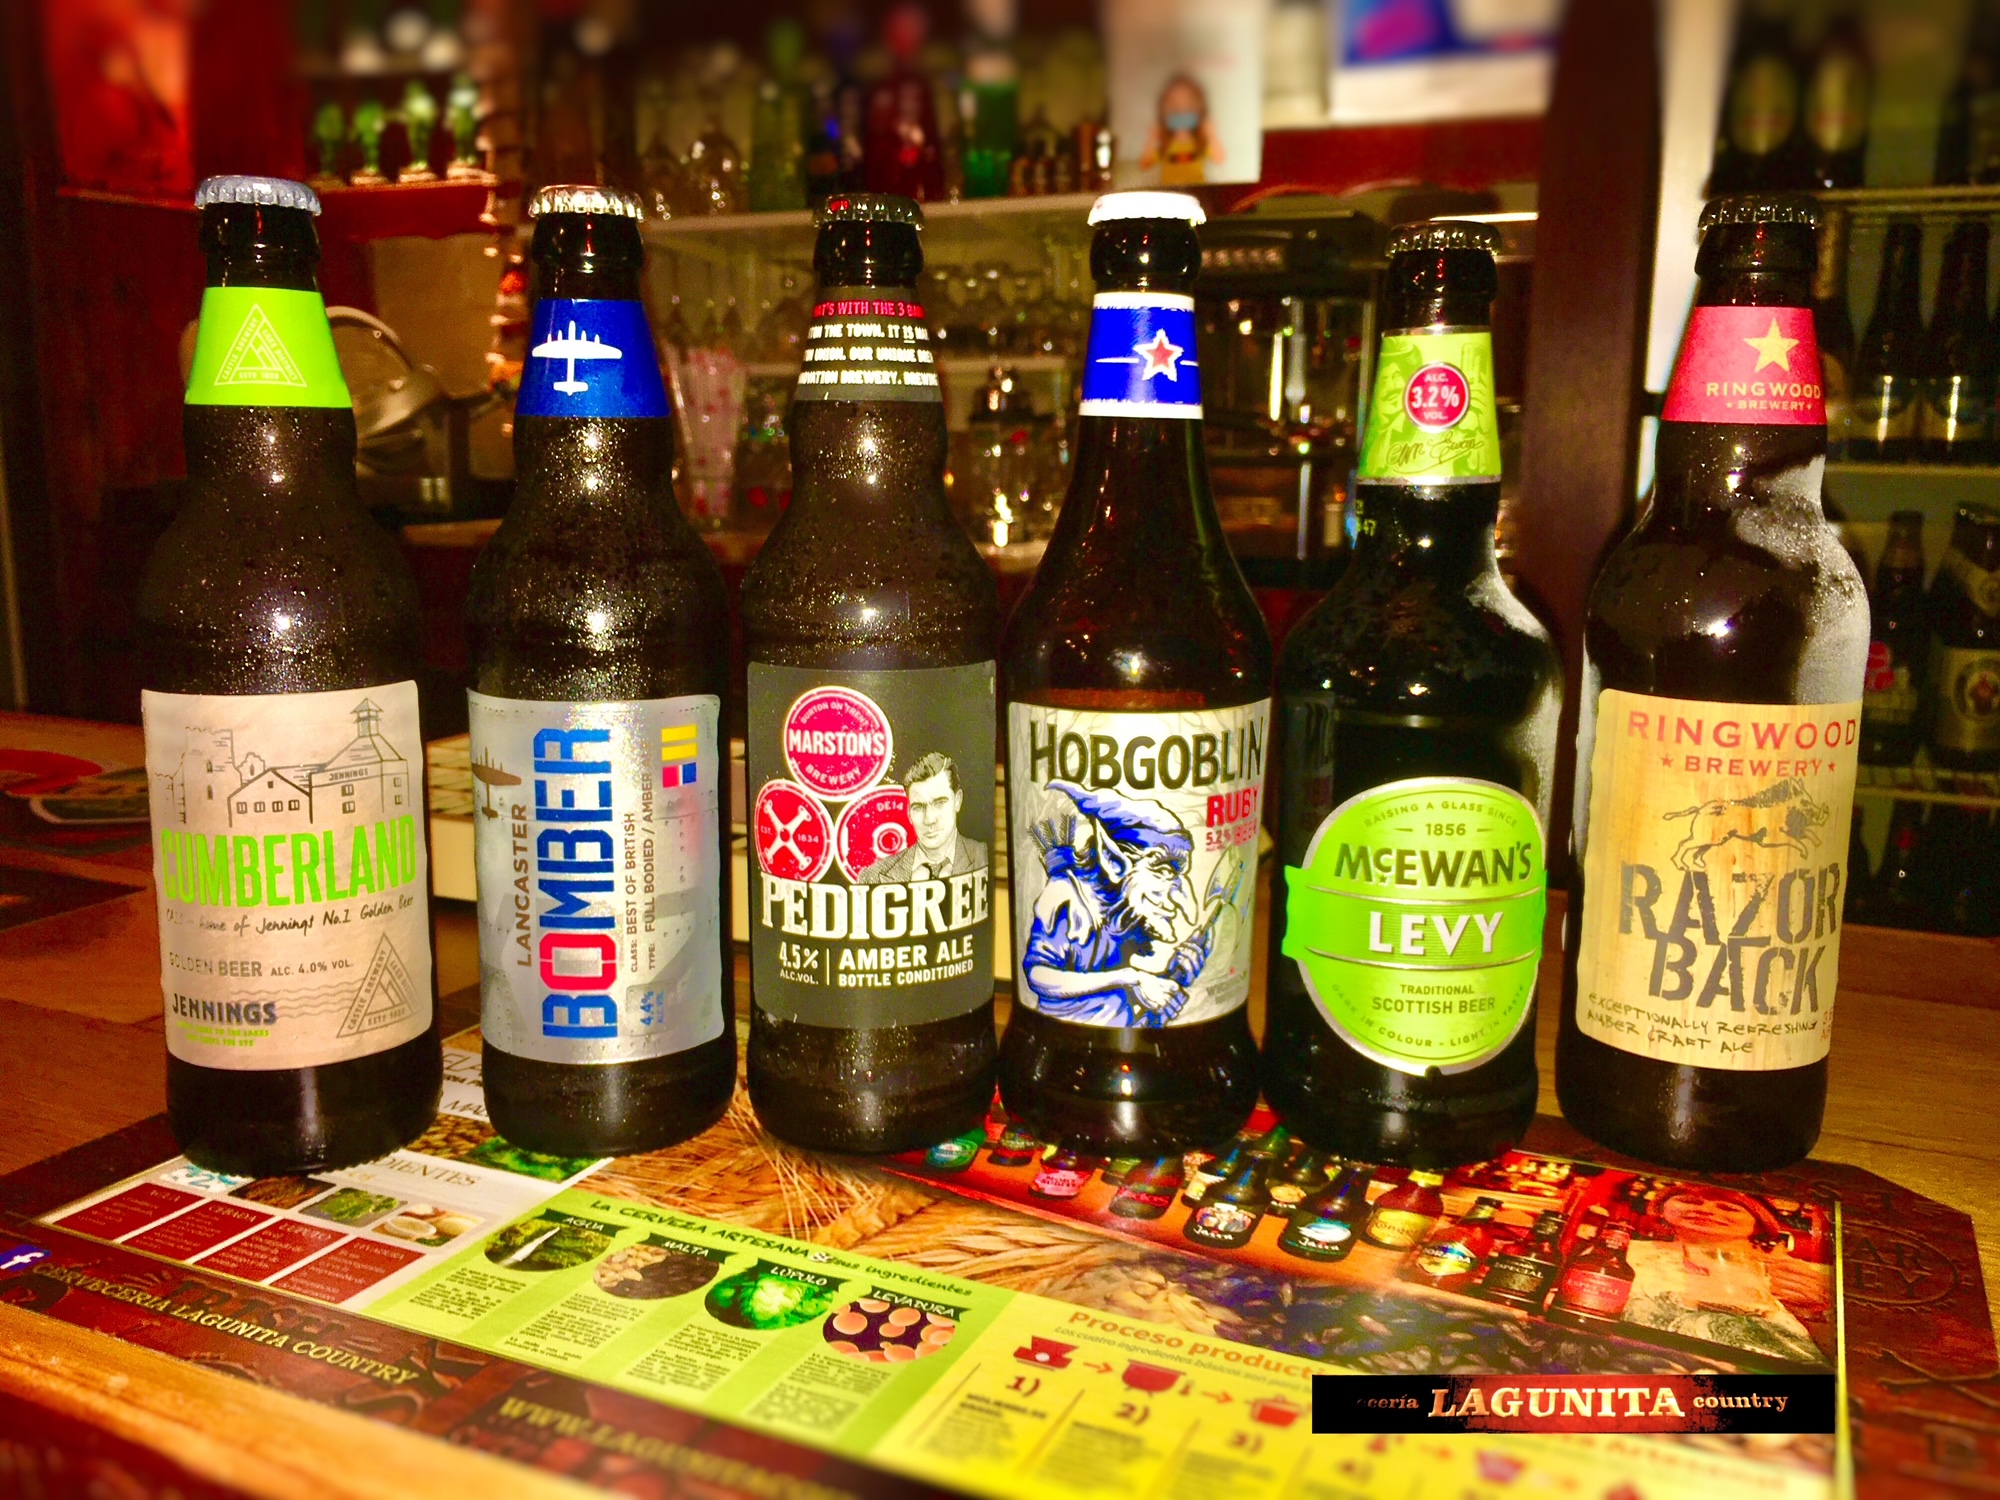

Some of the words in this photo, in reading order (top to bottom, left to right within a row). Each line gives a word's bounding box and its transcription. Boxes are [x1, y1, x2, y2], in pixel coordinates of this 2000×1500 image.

[837, 301, 869, 314] WITH
[873, 301, 895, 316] THE
[898, 302, 905, 316] 3
[824, 323, 843, 338] THE
[846, 323, 885, 338] TOWN.
[887, 324, 900, 338] IT
[902, 325, 914, 339] IS
[222, 354, 239, 380] CASTLE
[849, 346, 873, 361] OUR
[876, 346, 917, 363] UNIQUE
[840, 370, 902, 385] BREWERY.
[1424, 373, 1448, 382] ALC.
[1706, 382, 1821, 399] RINGWOOD
[1411, 385, 1460, 408] 3.2%
[1738, 400, 1805, 411] BREWERY
[1423, 411, 1448, 420] VOL.
[800, 701, 829, 725] BURTON
[830, 701, 843, 710] ON
[844, 702, 870, 726] TRENT
[1627, 711, 1856, 750] RINGWOOD
[1029, 715, 1265, 790] HOBGOBLIN
[1684, 755, 1824, 777] BREWERY
[329, 768, 369, 781] JENNINGS
[805, 763, 862, 786] BREWERY
[641, 773, 653, 823] AMBER
[876, 801, 904, 812] DE14
[1206, 783, 1259, 828] RUBY
[1364, 803, 1419, 828] RAISING
[1425, 802, 1434, 810] A
[1441, 801, 1482, 812] GLASS
[1487, 807, 1518, 829] SINCE
[624, 813, 636, 871] BRITISH
[761, 825, 773, 836] EST.
[797, 833, 819, 843] 1834
[1425, 823, 1466, 837] 1856
[160, 813, 417, 908] CUMBERLAND
[642, 838, 655, 894] BODIED
[510, 803, 533, 967] LANCASTER
[533, 727, 618, 1039] BOMBER
[625, 876, 637, 895] OF
[644, 897, 655, 933] FULL
[760, 867, 989, 941] PEDIGREE
[1618, 860, 1841, 946] RAZOR
[234, 915, 250, 937] of
[256, 914, 314, 937] Jennings
[360, 902, 394, 921] Golden
[625, 901, 638, 935] BEST
[1368, 911, 1504, 957] LEVY
[169, 951, 214, 973] GOLDEN
[218, 960, 263, 977] BEER
[271, 965, 294, 977] ALC.
[298, 961, 328, 974] 4.0%
[332, 959, 354, 970] VOL.
[630, 939, 639, 973] CLASS:
[648, 942, 656, 971] TYPE:
[779, 941, 820, 970] 4.5%
[838, 945, 928, 971] AMBER
[936, 934, 974, 960] ALE
[838, 971, 892, 987] BOTTLE
[896, 958, 974, 986] CONDITIONED
[1648, 930, 1826, 1016] BACK
[1400, 984, 1475, 995] TRADITIONAL
[172, 992, 277, 1026] JENNINGS
[347, 997, 367, 1031] CASTLE
[640, 991, 654, 1026] 4.4%
[1360, 1015, 1375, 1028] IN
[1378, 1026, 1433, 1047] COLOUR
[1450, 1028, 1485, 1047] LIGHT
[1488, 1020, 1500, 1031] IN
[1503, 985, 1525, 1017] TASTE
[1372, 996, 1453, 1014] SCOTTISH
[1458, 997, 1495, 1014] BEER
[1587, 1009, 1640, 1035] AMBER
[1647, 1024, 1711, 1050] CRAFT
[563, 1216, 604, 1232] AGUA
[590, 1200, 611, 1212] La
[619, 1207, 708, 1234] CERVEZA
[711, 1229, 810, 1258] ARTESANA
[832, 1258, 860, 1270] sus
[865, 1265, 973, 1297] ingredientes
[662, 1240, 710, 1257] MALTA
[873, 1289, 956, 1318] LEVADURA
[33, 1262, 171, 1312] CERVECERIA
[171, 1304, 291, 1348] LAGUNITA
[292, 1340, 419, 1385] COUNTRY
[1068, 1311, 1184, 1349] Proceso
[1054, 1326, 1078, 1338] Los
[1082, 1331, 1117, 1348] cuatro
[1117, 1339, 1194, 1367] ingredientes
[1006, 1376, 1041, 1398] 1)
[1114, 1402, 1150, 1427] 2)
